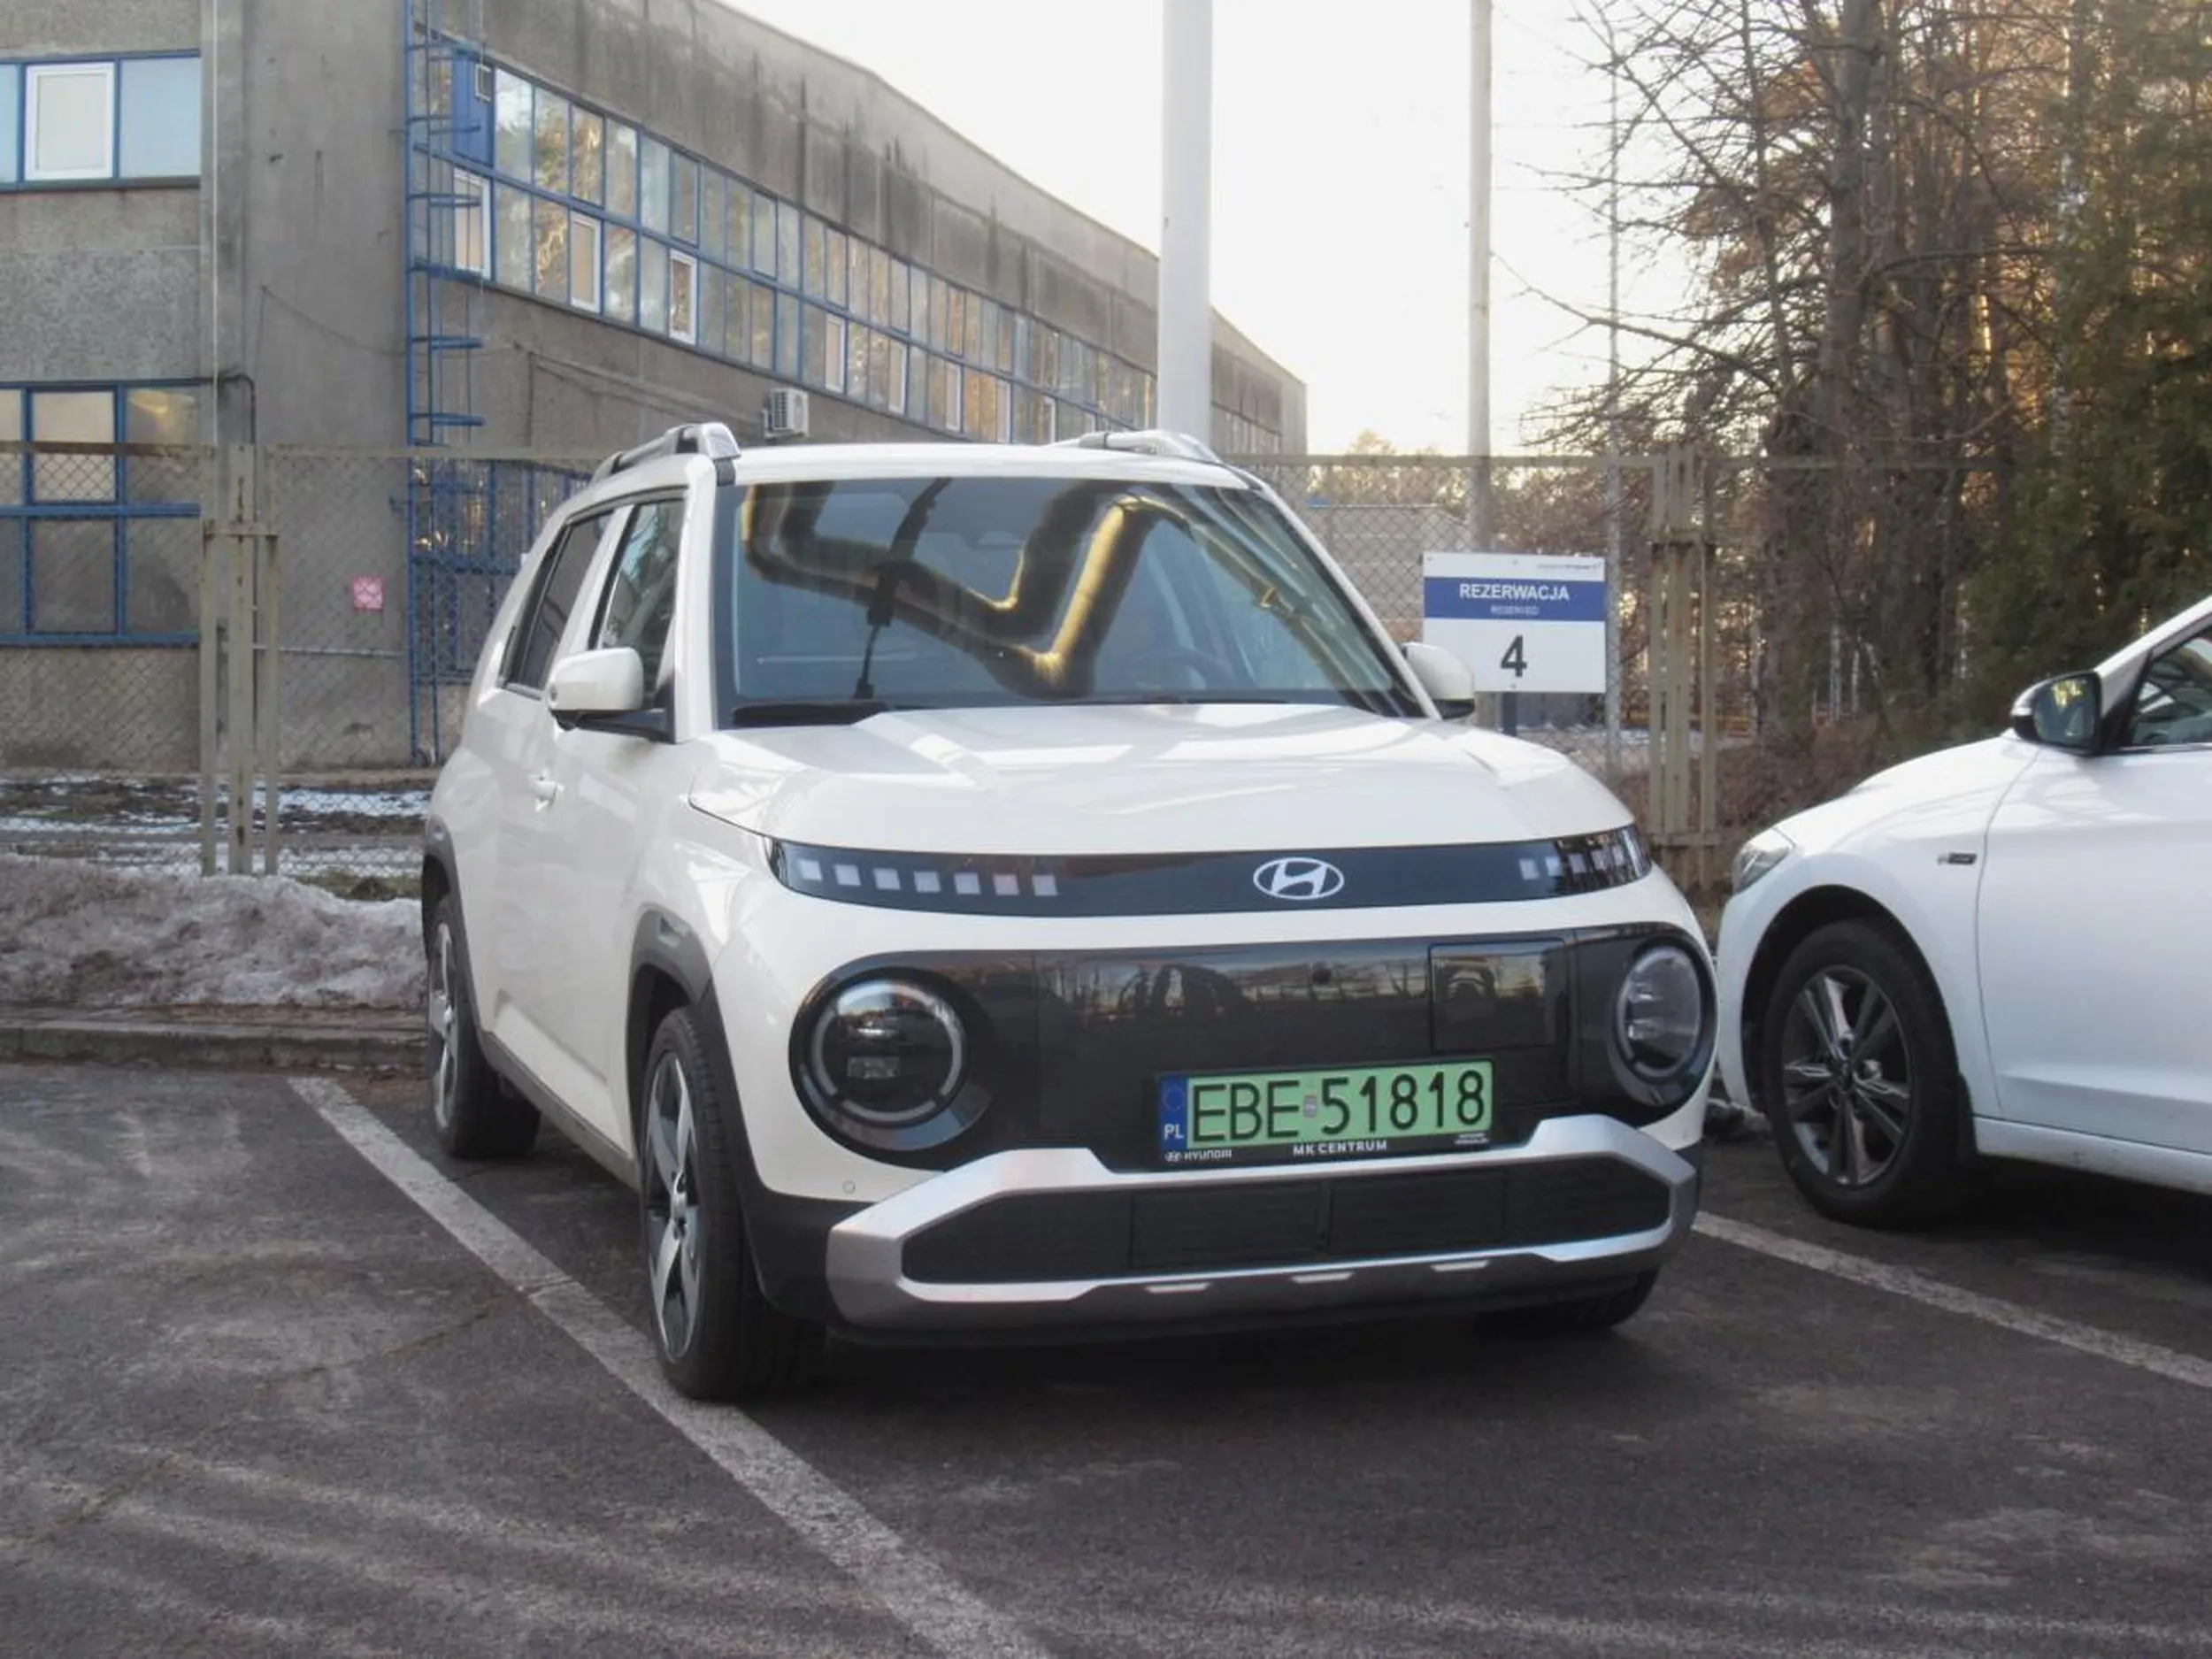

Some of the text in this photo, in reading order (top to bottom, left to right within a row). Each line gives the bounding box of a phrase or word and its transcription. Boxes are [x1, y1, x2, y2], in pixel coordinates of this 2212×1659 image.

[1460, 583, 1569, 600] REZERWACJA
[1501, 634, 1528, 678] 4
[1193, 1070, 1485, 1143] EBE 51818
[1164, 1123, 1185, 1140] PL
[1293, 1140, 1387, 1156] MK CENTRUM
